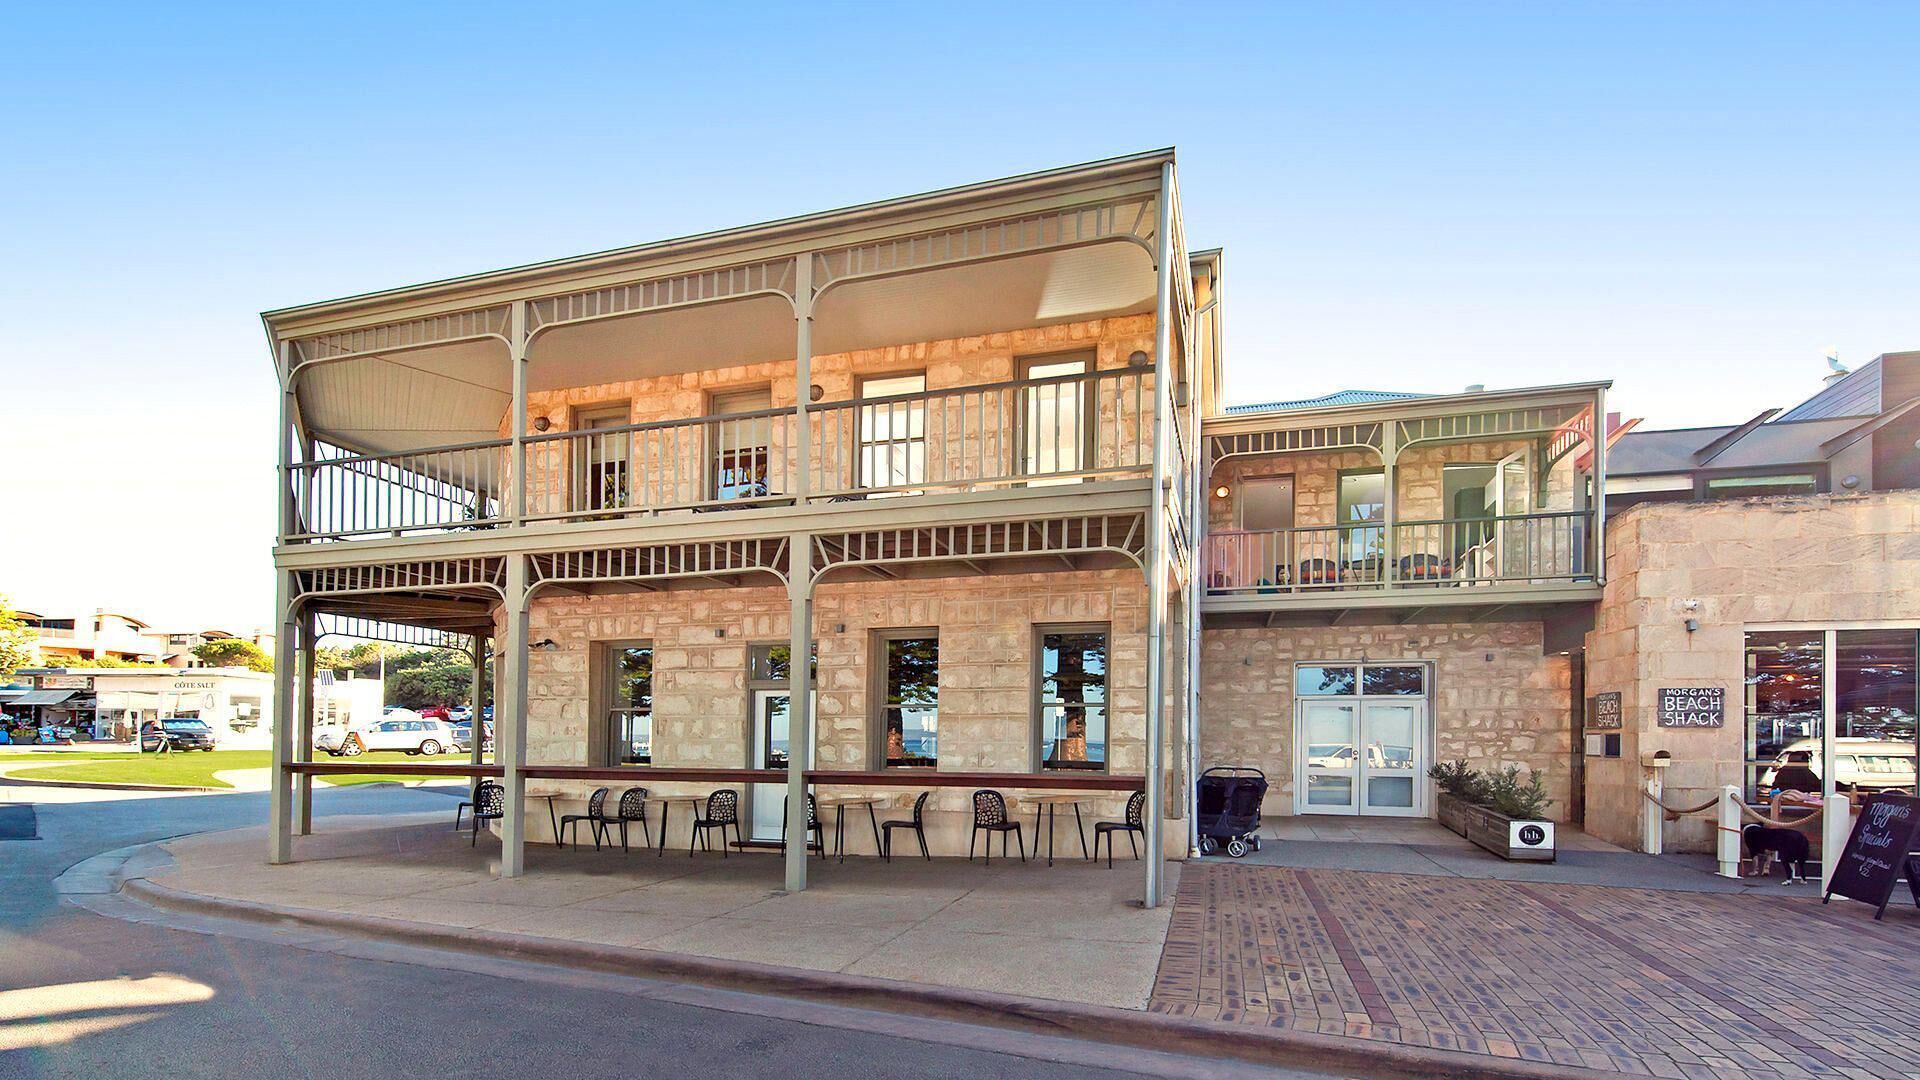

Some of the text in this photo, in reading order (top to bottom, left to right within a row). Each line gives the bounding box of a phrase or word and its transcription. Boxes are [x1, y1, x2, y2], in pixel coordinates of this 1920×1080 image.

[1666, 688, 1721, 696] MORGAN'S
[1598, 700, 1618, 715] BEACH
[1664, 696, 1721, 711] BEACH
[1597, 714, 1619, 727] SHACK
[1665, 711, 1720, 726] SHACK
[1869, 801, 1912, 828] Morgan's
[1858, 823, 1893, 849] Specials
